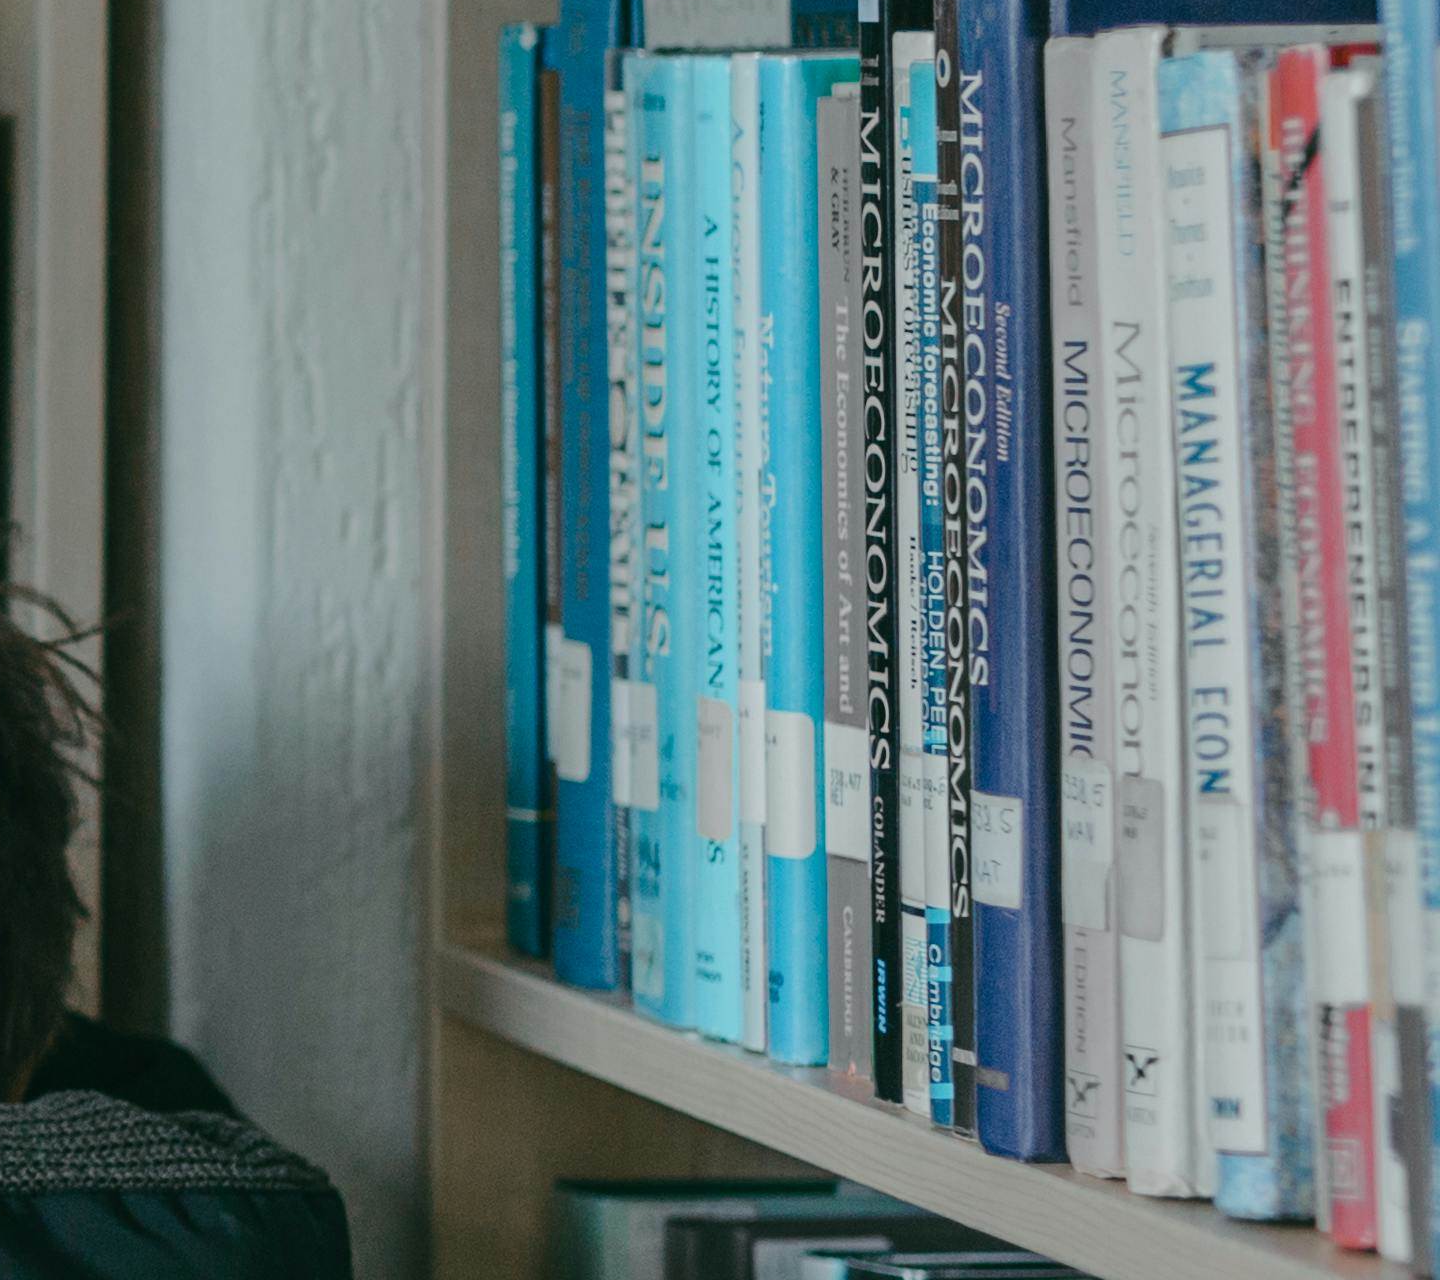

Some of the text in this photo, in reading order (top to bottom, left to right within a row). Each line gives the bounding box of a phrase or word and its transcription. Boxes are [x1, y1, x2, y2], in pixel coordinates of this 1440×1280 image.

[830, 192, 841, 252] GRAY
[1061, 117, 1084, 307] Mansfield
[1109, 69, 1136, 258] MANSFIELD
[640, 157, 670, 495] INSIDE
[861, 107, 891, 770] MICROECONOMICS
[922, 202, 942, 508] Economic forecasting:
[960, 70, 988, 685] MICROECONOMICS
[995, 302, 1012, 462] Second Edition
[703, 217, 725, 688] A HISTORY OF AMERICAN
[836, 300, 853, 714] The Economics of Art and
[1176, 360, 1231, 656] MANAGERIAL
[1336, 279, 1372, 726] ENTREPRENEURS
[927, 552, 947, 678] HOLDEN,
[941, 277, 969, 920] MICROECONOMICS
[842, 906, 854, 1038] CAMBRIDGE
[873, 796, 886, 920] COLANDER
[875, 958, 888, 1034] IRWIN
[928, 940, 944, 1082] Cambridge
